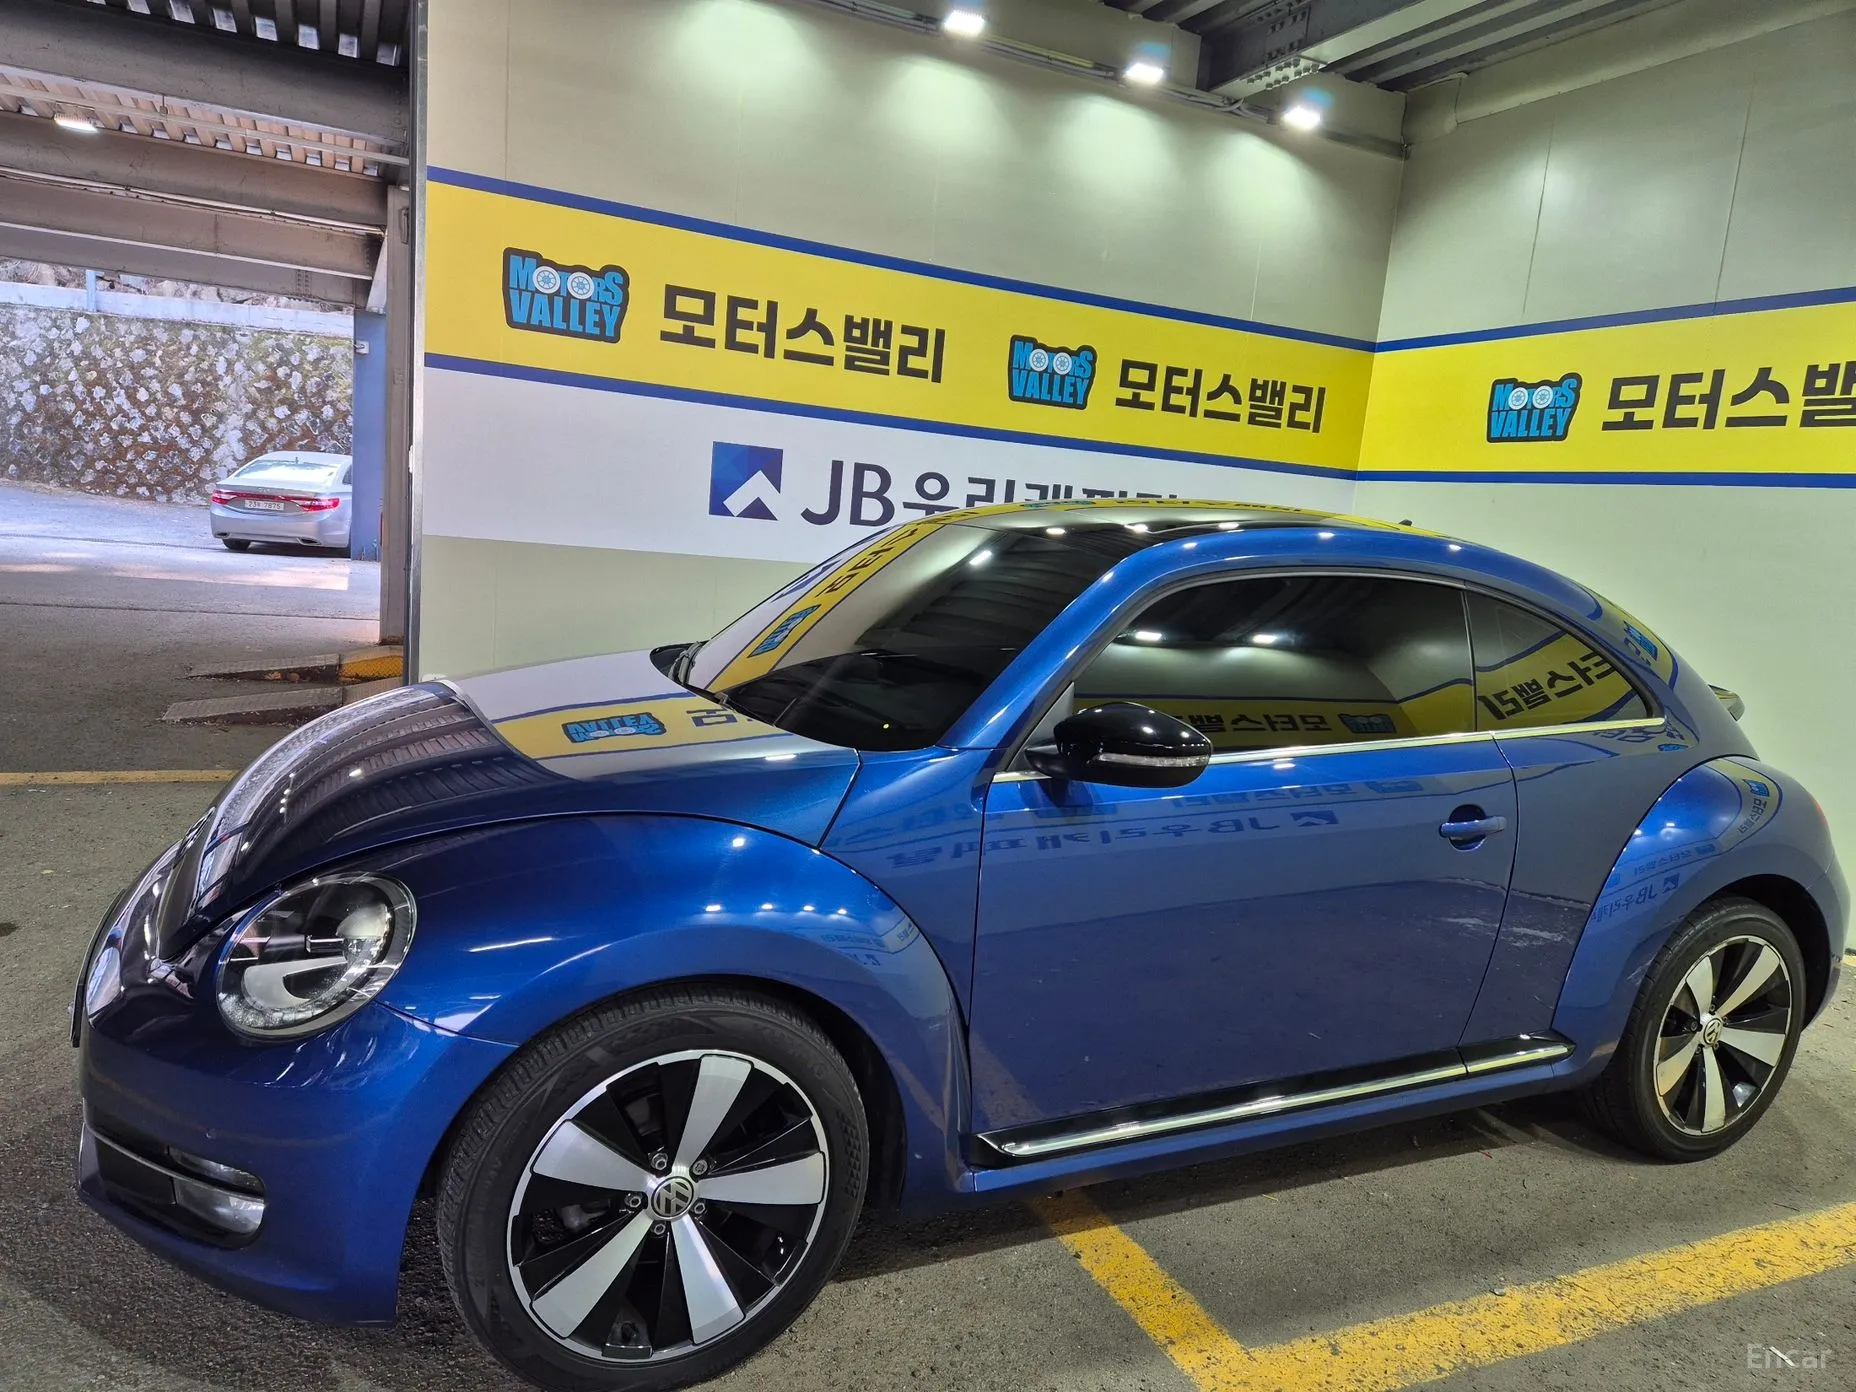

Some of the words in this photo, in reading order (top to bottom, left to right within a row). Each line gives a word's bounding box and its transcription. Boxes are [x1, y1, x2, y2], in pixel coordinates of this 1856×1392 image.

[510, 290, 621, 338] VALLEY
[660, 284, 946, 383] 모터스밸리
[1012, 368, 1090, 405] VALLEY
[1115, 358, 1327, 433] 모터스밸리
[1490, 408, 1572, 439] VALLEY
[800, 459, 1190, 527] JB우리
